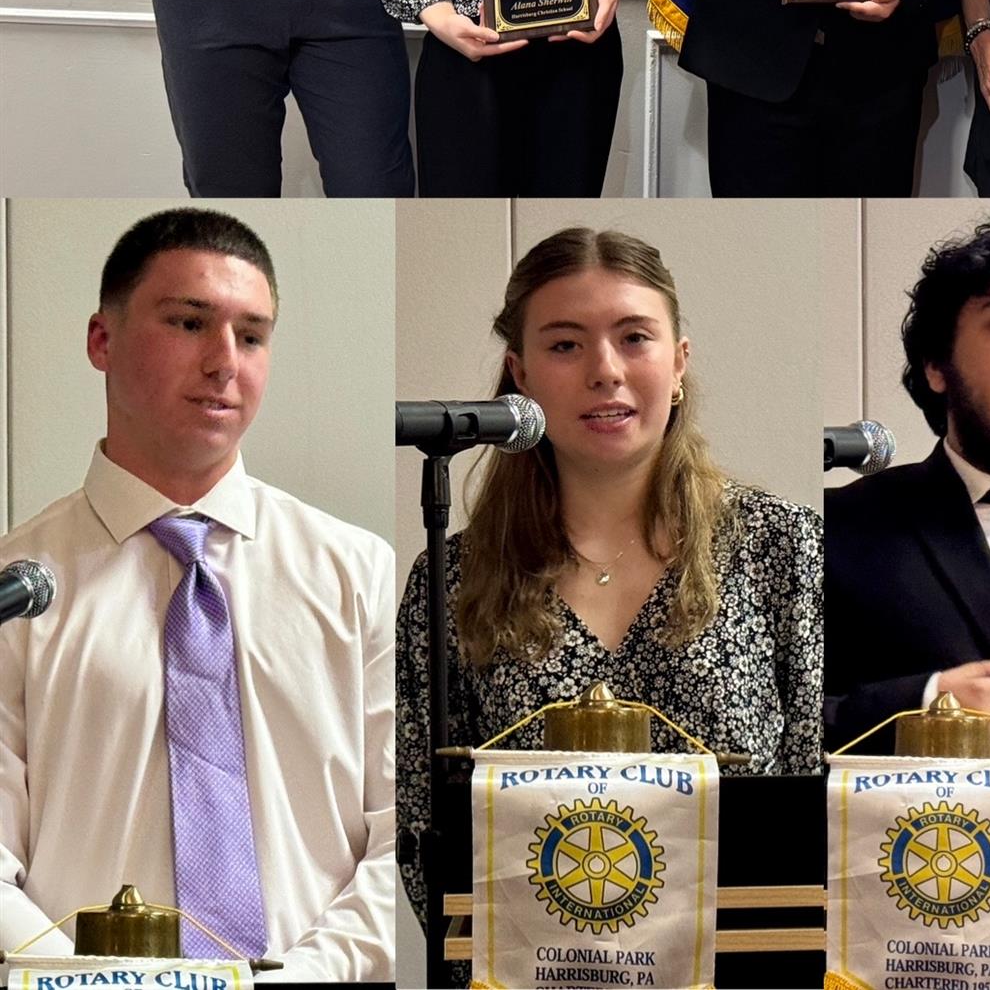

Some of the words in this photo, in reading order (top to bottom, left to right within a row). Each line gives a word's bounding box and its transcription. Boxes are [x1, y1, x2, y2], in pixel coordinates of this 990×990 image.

[511, 1, 536, 10] Alana
[500, 765, 611, 790] ROTARY
[620, 764, 694, 795] CLUB
[588, 782, 607, 794] OF
[854, 770, 958, 794] ROTARY
[936, 786, 954, 798] OF
[570, 812, 624, 827] ROTARY
[919, 813, 969, 828] ROTARY
[549, 884, 644, 919] INTERNATIONAL
[899, 882, 988, 914] INTERNATIONAL
[536, 947, 614, 964] COLONIAL
[616, 951, 656, 965] PARK
[887, 939, 959, 957] COLONIAL
[535, 967, 633, 986] HARRISBURG,
[636, 971, 655, 985] PA
[885, 959, 978, 978] HARRISBURG,
[37, 970, 146, 990] ROTARY
[884, 976, 969, 990] CHARTERED
